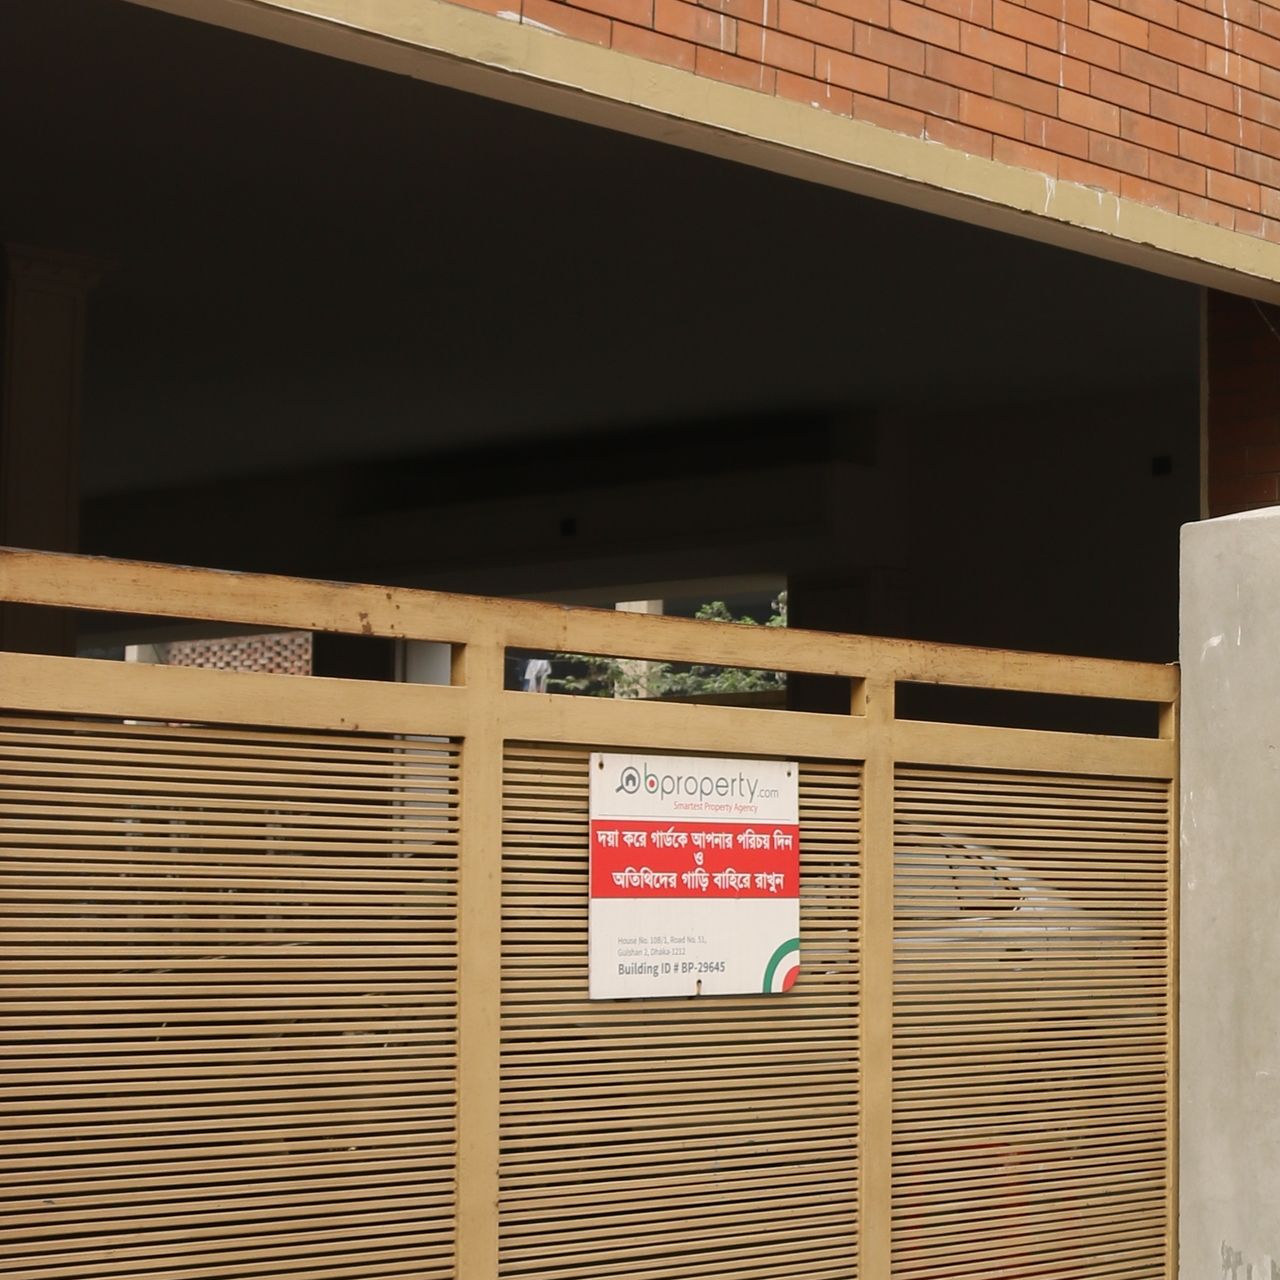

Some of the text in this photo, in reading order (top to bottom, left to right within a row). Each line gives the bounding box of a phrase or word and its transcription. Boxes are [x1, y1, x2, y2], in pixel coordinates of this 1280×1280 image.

[673, 801, 759, 814] Smartest Property Agency
[596, 826, 793, 851] দয়া করে গার্ডকে আপনার পরিচয় দিন
[693, 851, 704, 866] ও
[612, 867, 785, 893] অতিথিদের গাড়ি বাহিরে রাখুন
[618, 936, 637, 945] House
[670, 936, 686, 945] Road
[618, 963, 660, 978] Building
[661, 962, 672, 974] ID
[681, 961, 726, 974] BP-29645
